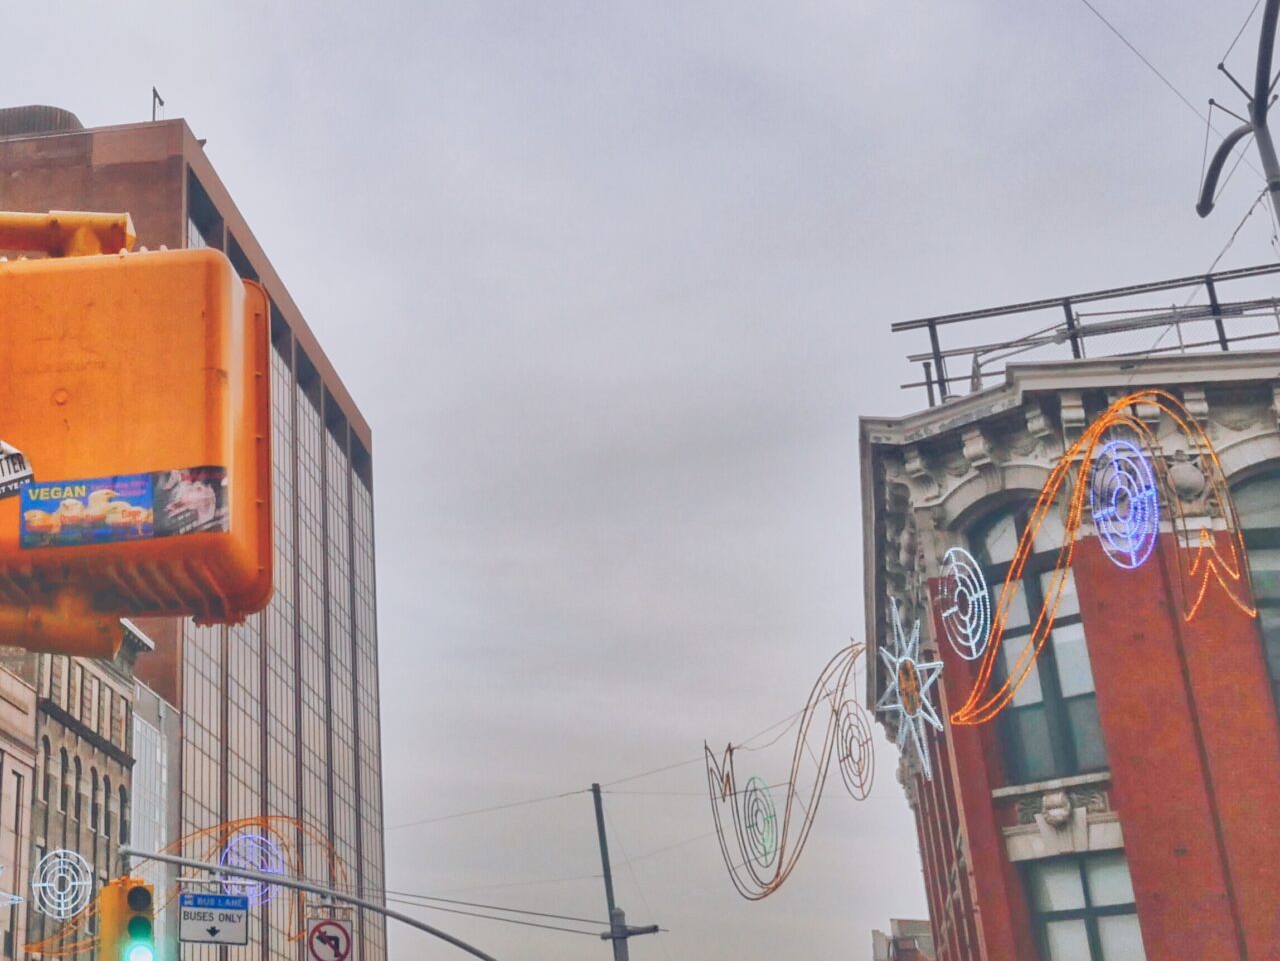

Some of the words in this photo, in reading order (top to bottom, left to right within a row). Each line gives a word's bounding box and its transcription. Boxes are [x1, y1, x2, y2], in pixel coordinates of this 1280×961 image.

[28, 485, 86, 501] VEGAN
[196, 897, 215, 906] BUS
[183, 911, 214, 921] BUSES
[218, 913, 243, 923] ONLY
